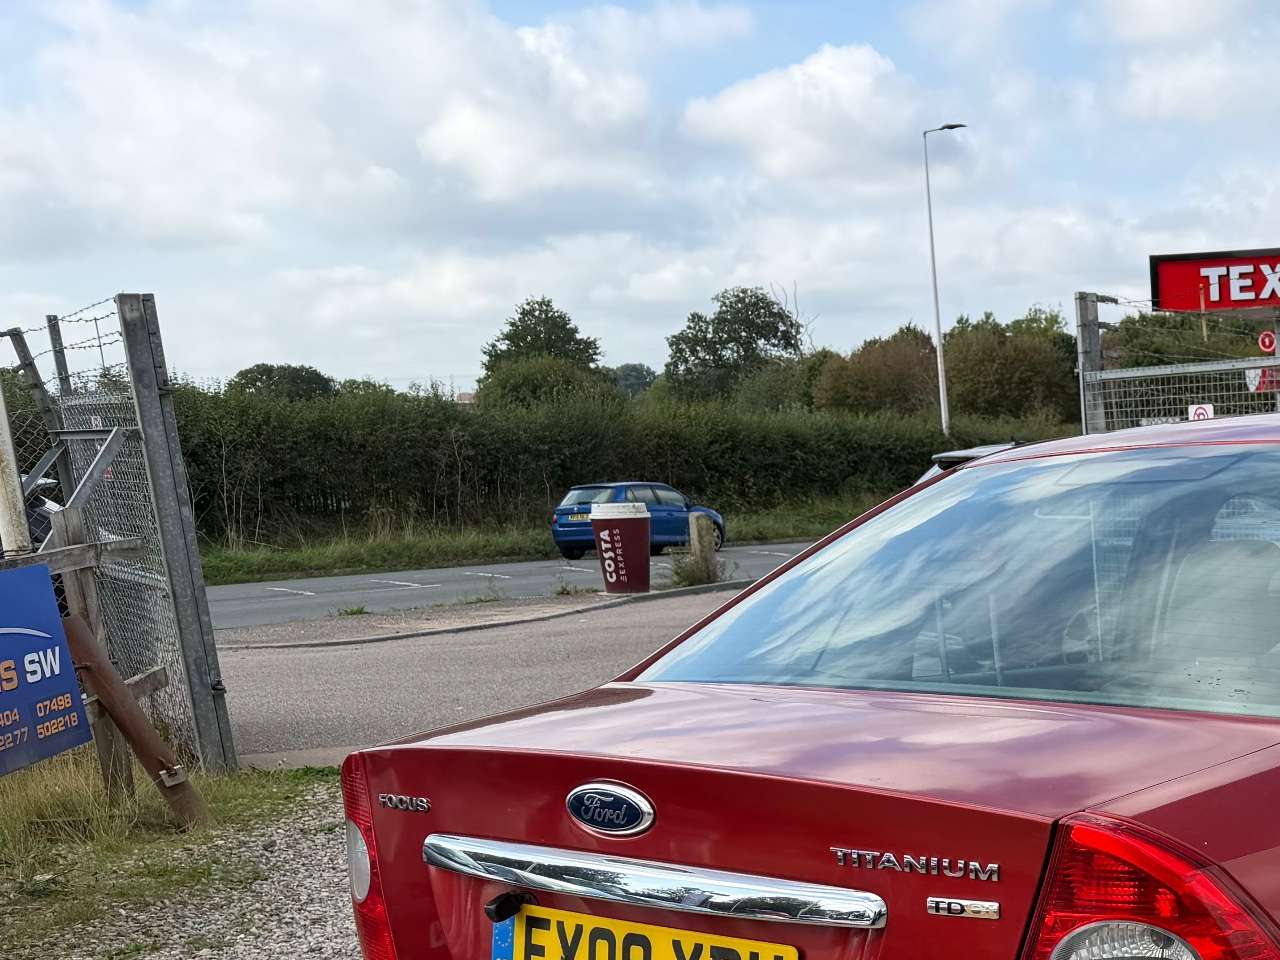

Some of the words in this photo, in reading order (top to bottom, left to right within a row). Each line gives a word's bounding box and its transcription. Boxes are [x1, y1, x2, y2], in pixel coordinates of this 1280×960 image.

[600, 529, 617, 583] COSTA
[612, 528, 626, 575] EXPRESS
[24, 646, 60, 684] SW
[36, 693, 73, 719] 07498
[378, 793, 431, 813] FOCUS
[583, 793, 628, 826] Ford
[829, 846, 1000, 883] TITANIUM
